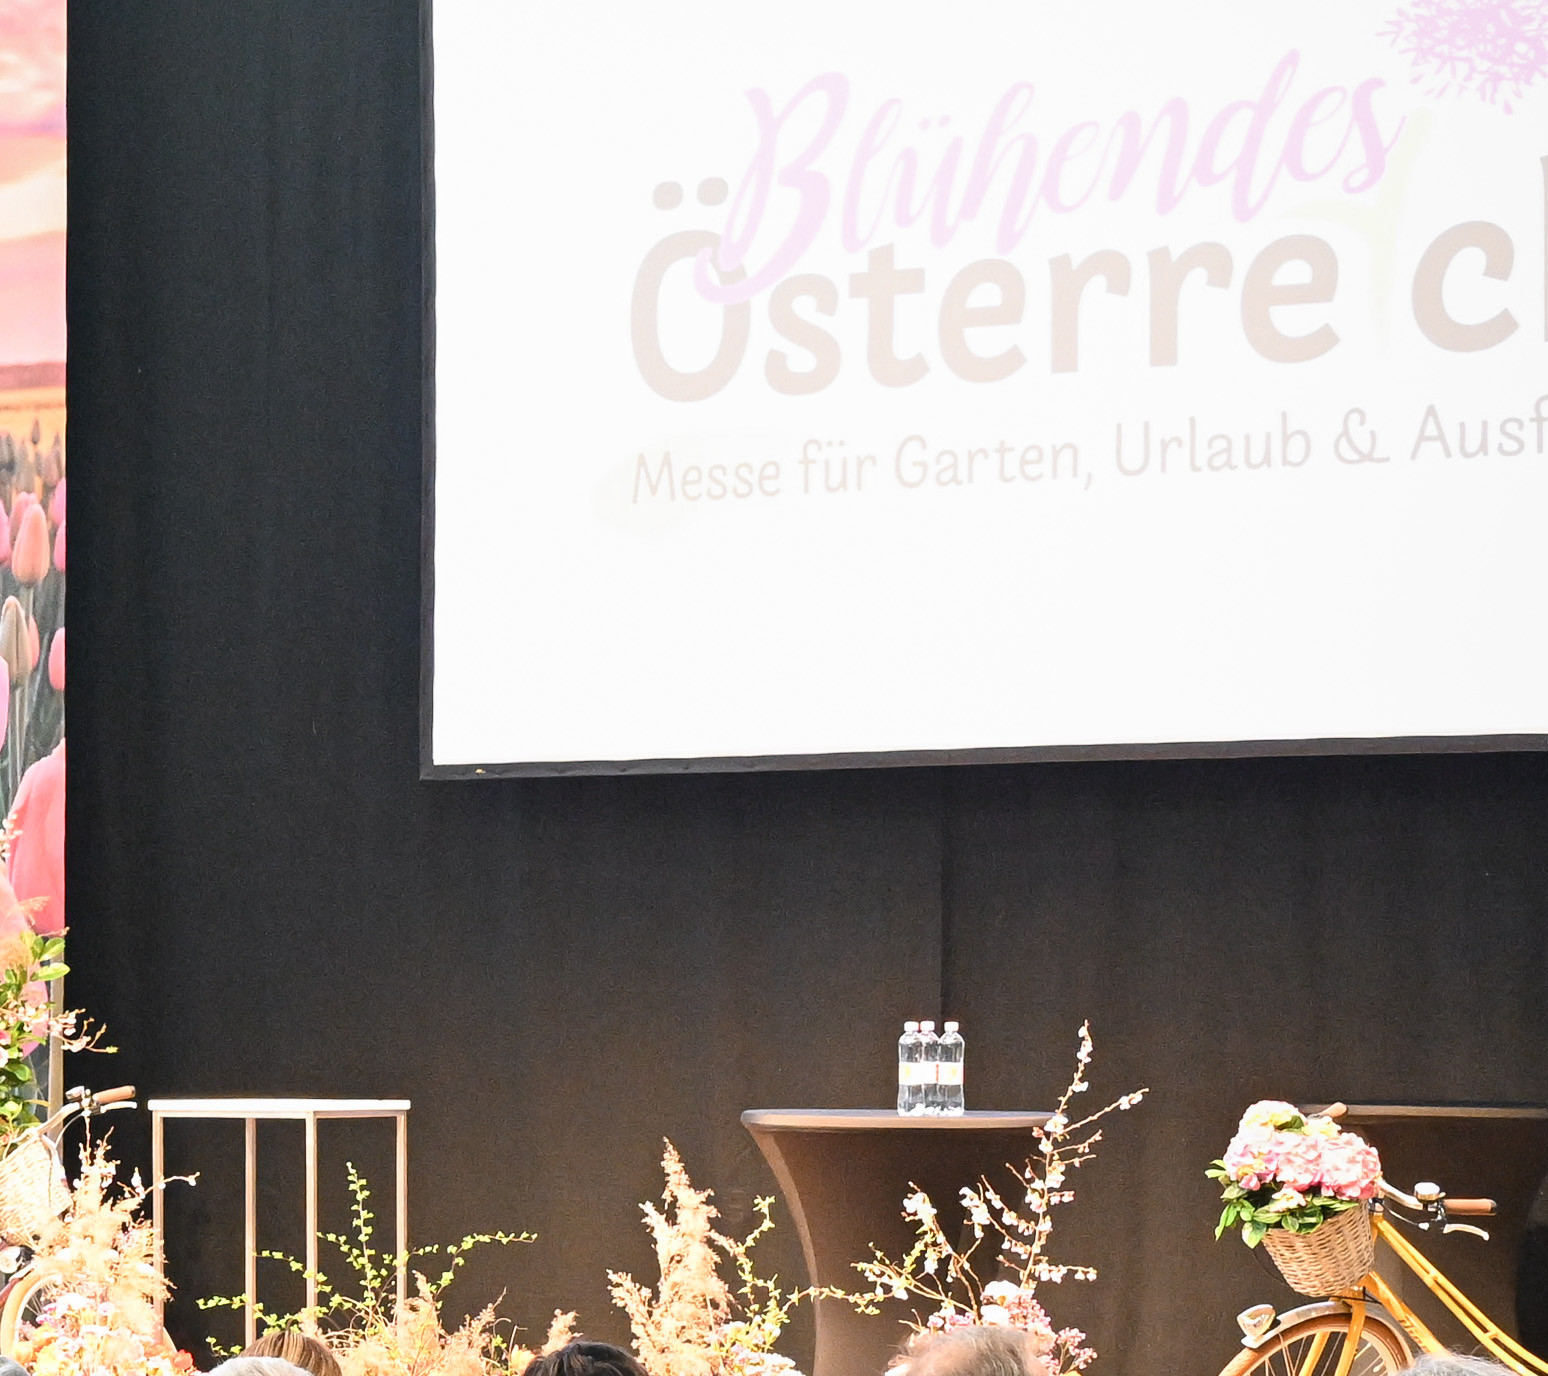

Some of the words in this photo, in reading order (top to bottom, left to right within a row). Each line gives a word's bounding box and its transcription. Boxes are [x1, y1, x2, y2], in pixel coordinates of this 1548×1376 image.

[693, 48, 1406, 304] Blühendes
[631, 450, 783, 504] Messe
[798, 438, 878, 496] für
[894, 430, 1097, 493] Garten,
[1114, 411, 1312, 477] Urlaub
[1333, 406, 1391, 464] &
